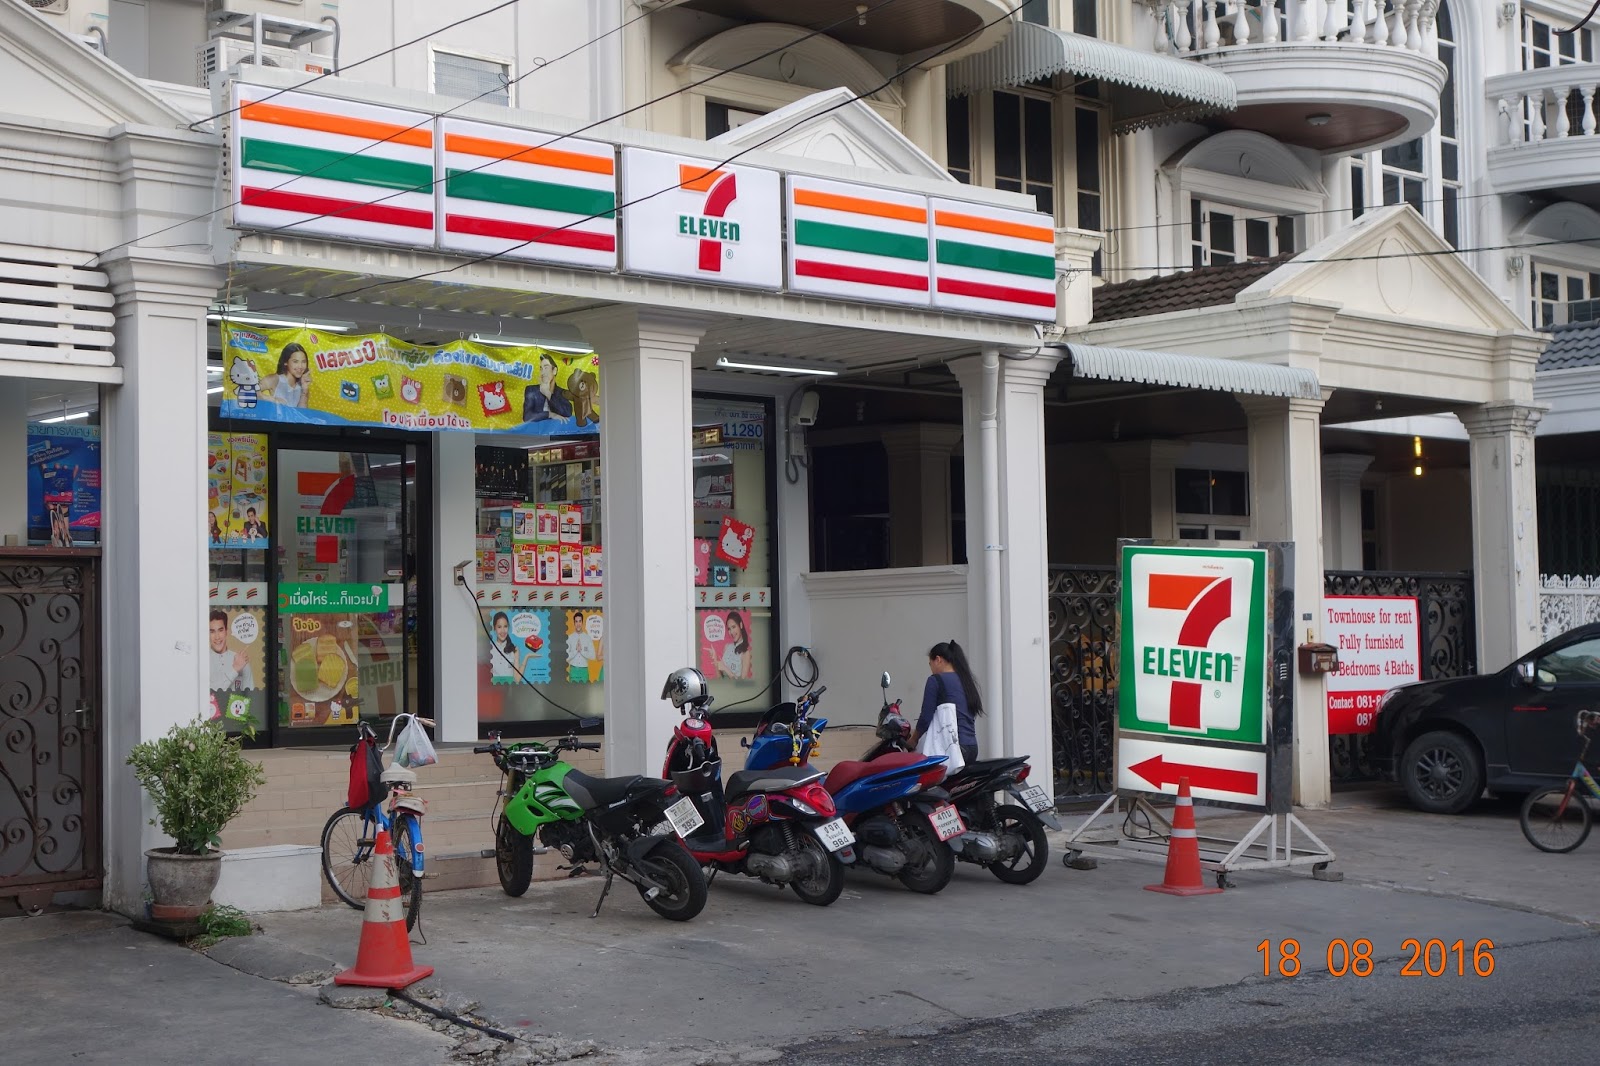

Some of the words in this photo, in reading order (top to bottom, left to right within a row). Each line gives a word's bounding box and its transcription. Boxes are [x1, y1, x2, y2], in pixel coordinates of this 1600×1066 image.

[679, 164, 737, 272] 7
[27, 425, 90, 437] รายการพิเศษ
[723, 423, 763, 438] 11280
[1327, 608, 1376, 624] Townhouse
[1379, 608, 1392, 624] for
[1394, 609, 1413, 624] rent
[1339, 634, 1361, 653] Fully
[1365, 633, 1404, 650] furnished
[1148, 573, 1232, 730] 7
[1339, 660, 1381, 677] Bedrooms
[1391, 660, 1415, 675] Baths
[1329, 696, 1354, 709] Contact
[1356, 695, 1382, 709] 081-8
[832, 836, 849, 848] 984
